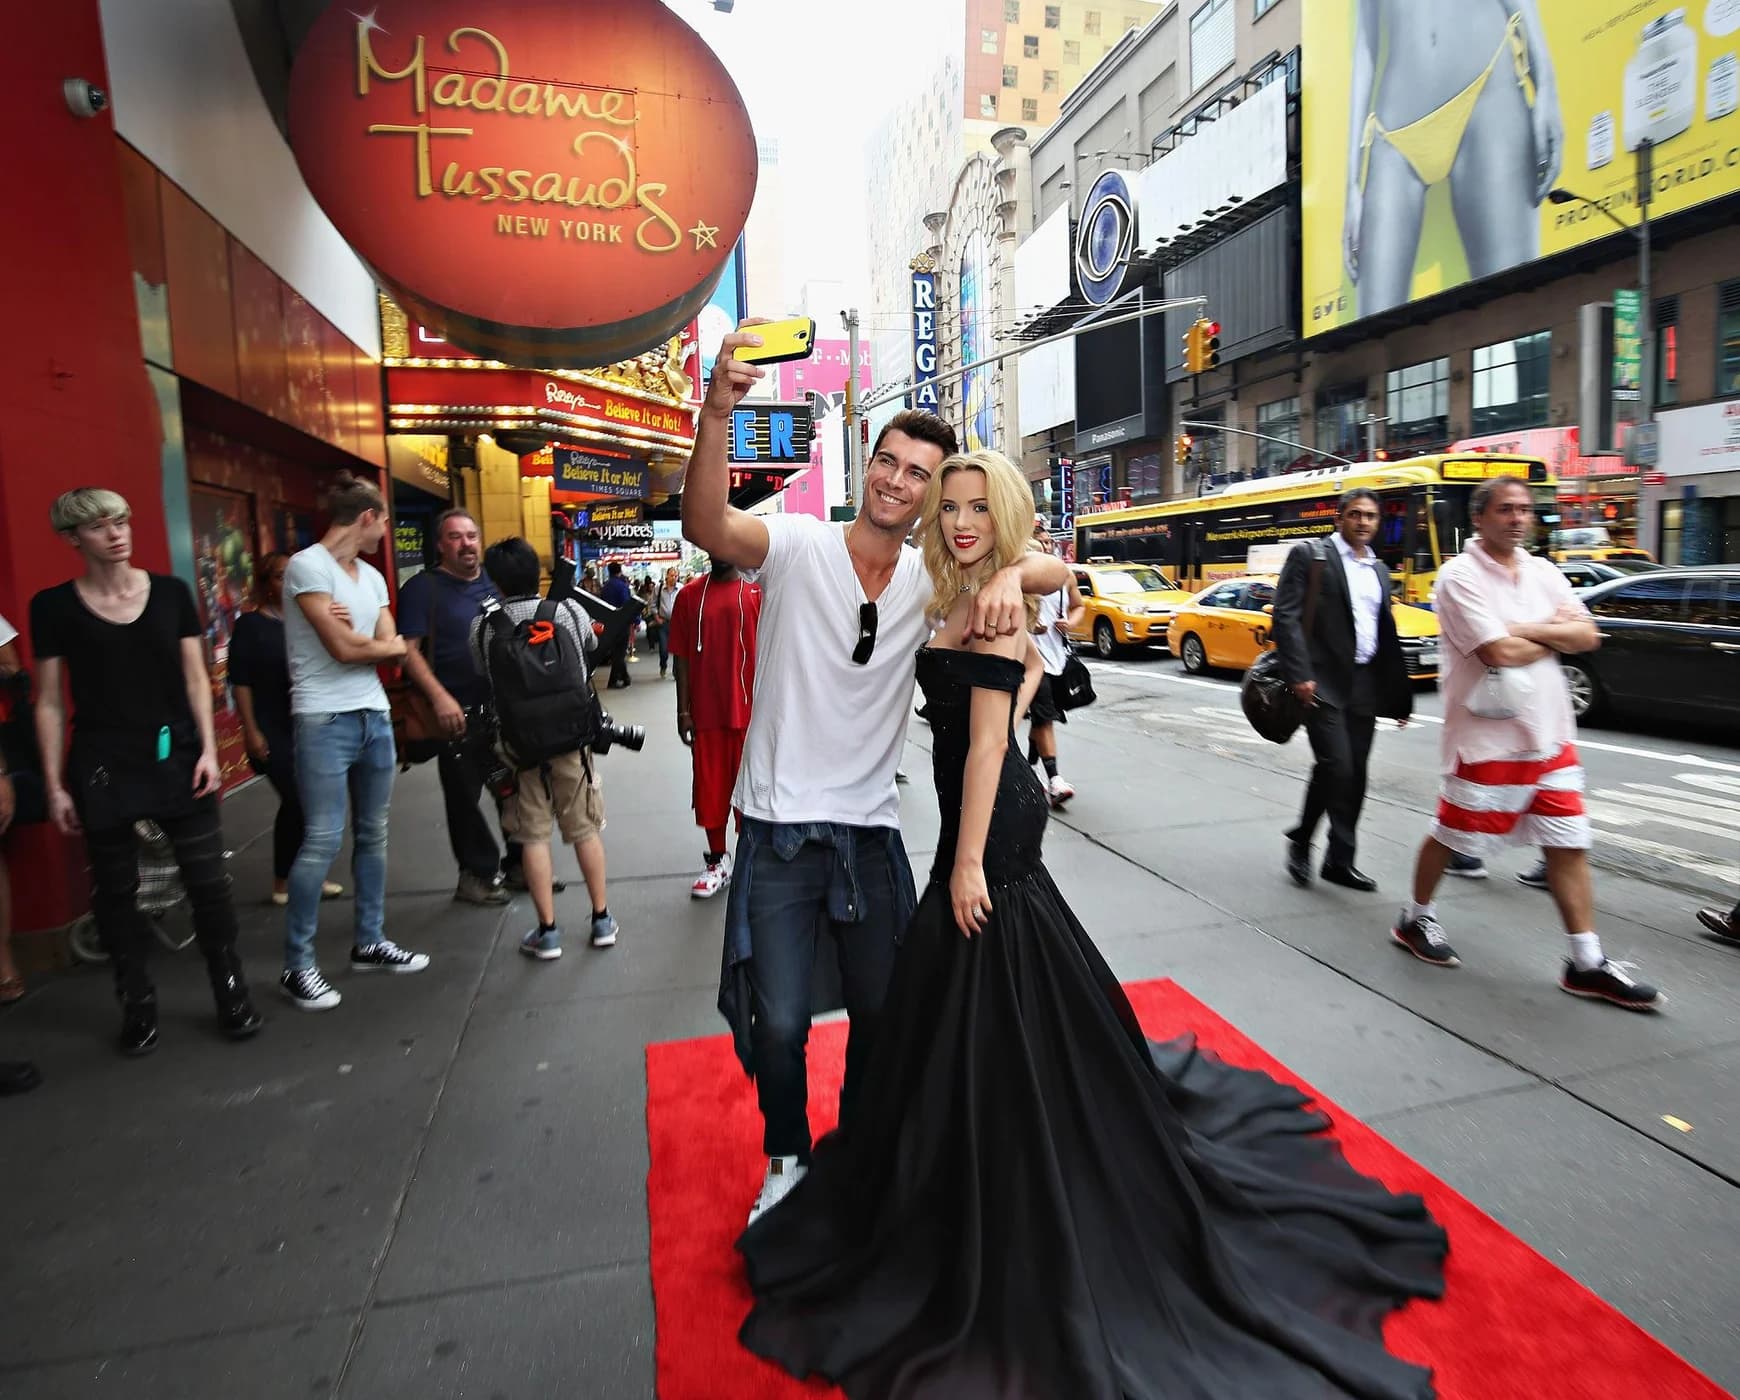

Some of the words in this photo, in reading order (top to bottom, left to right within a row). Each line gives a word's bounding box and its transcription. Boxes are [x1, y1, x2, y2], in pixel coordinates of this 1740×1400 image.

[357, 22, 640, 126] Madame
[368, 124, 682, 252] Tussauds
[497, 214, 549, 237] NEW
[560, 220, 623, 243] YORK
[913, 279, 938, 414] REGA
[605, 399, 640, 422] Believe
[642, 407, 651, 424] It
[652, 414, 662, 427] or
[663, 412, 681, 433] Not!
[1092, 426, 1126, 444] Panasonic
[562, 464, 599, 482] Believe
[600, 465, 610, 483] It
[611, 471, 621, 483] or
[623, 470, 643, 487] Not!
[591, 485, 613, 494] TIMES
[616, 487, 643, 497] SQUARE
